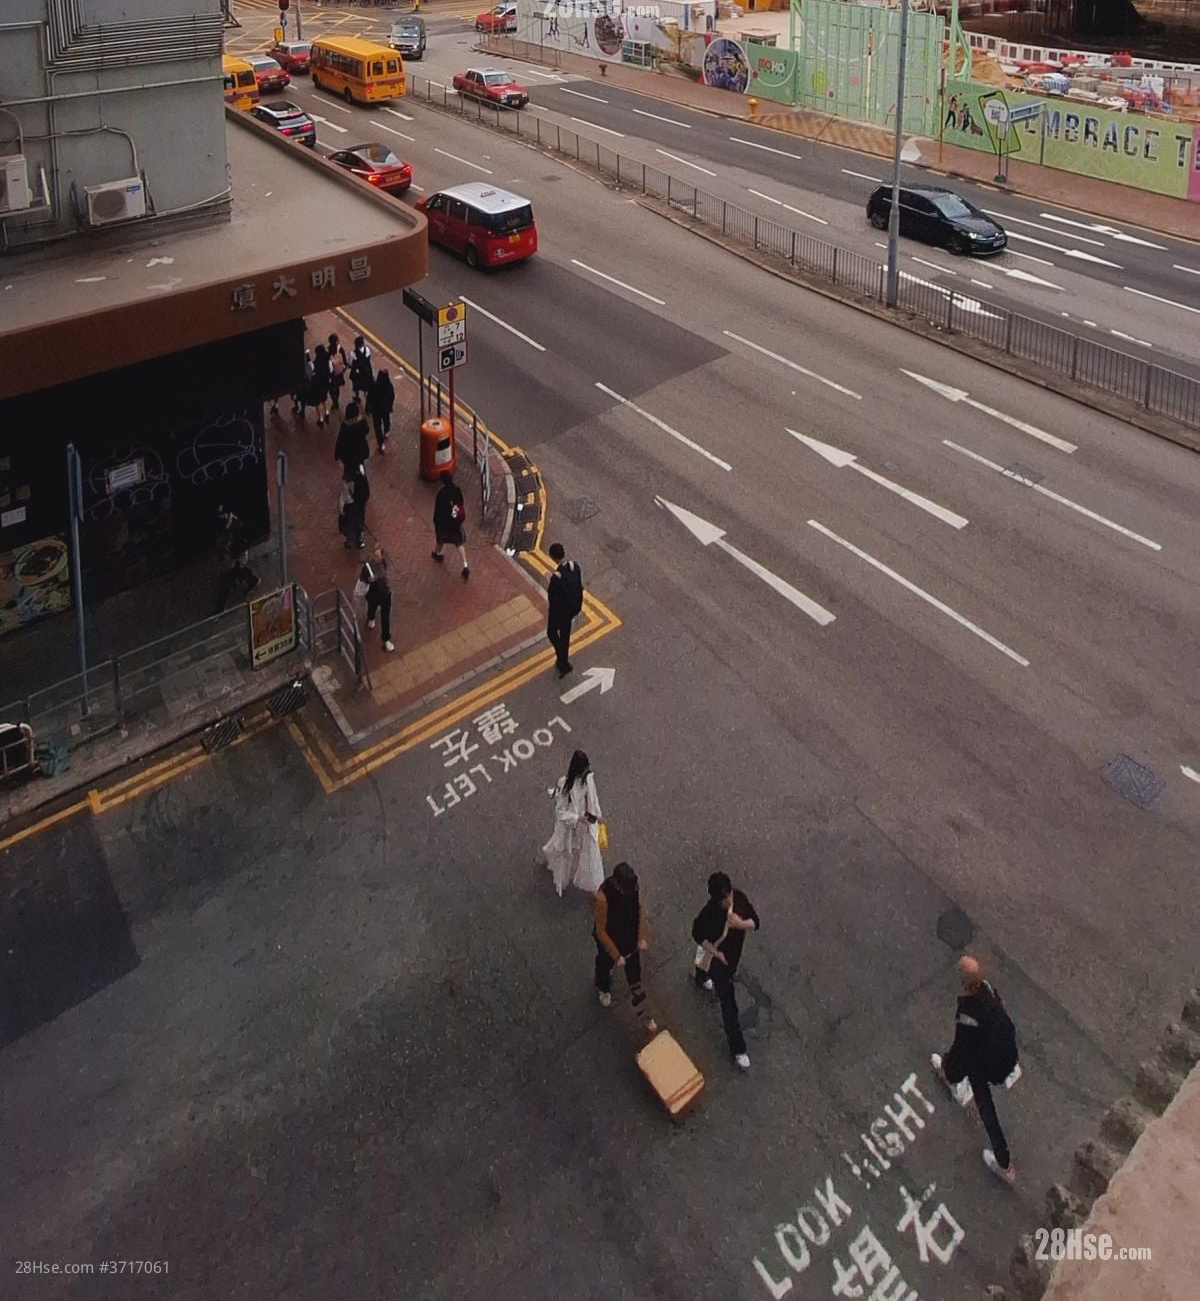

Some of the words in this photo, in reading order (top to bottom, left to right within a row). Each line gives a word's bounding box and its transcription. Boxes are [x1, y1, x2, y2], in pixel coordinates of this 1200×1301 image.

[491, 716, 572, 773] LOOK
[426, 764, 493, 817] LEFT
[752, 1176, 852, 1300] LOOK
